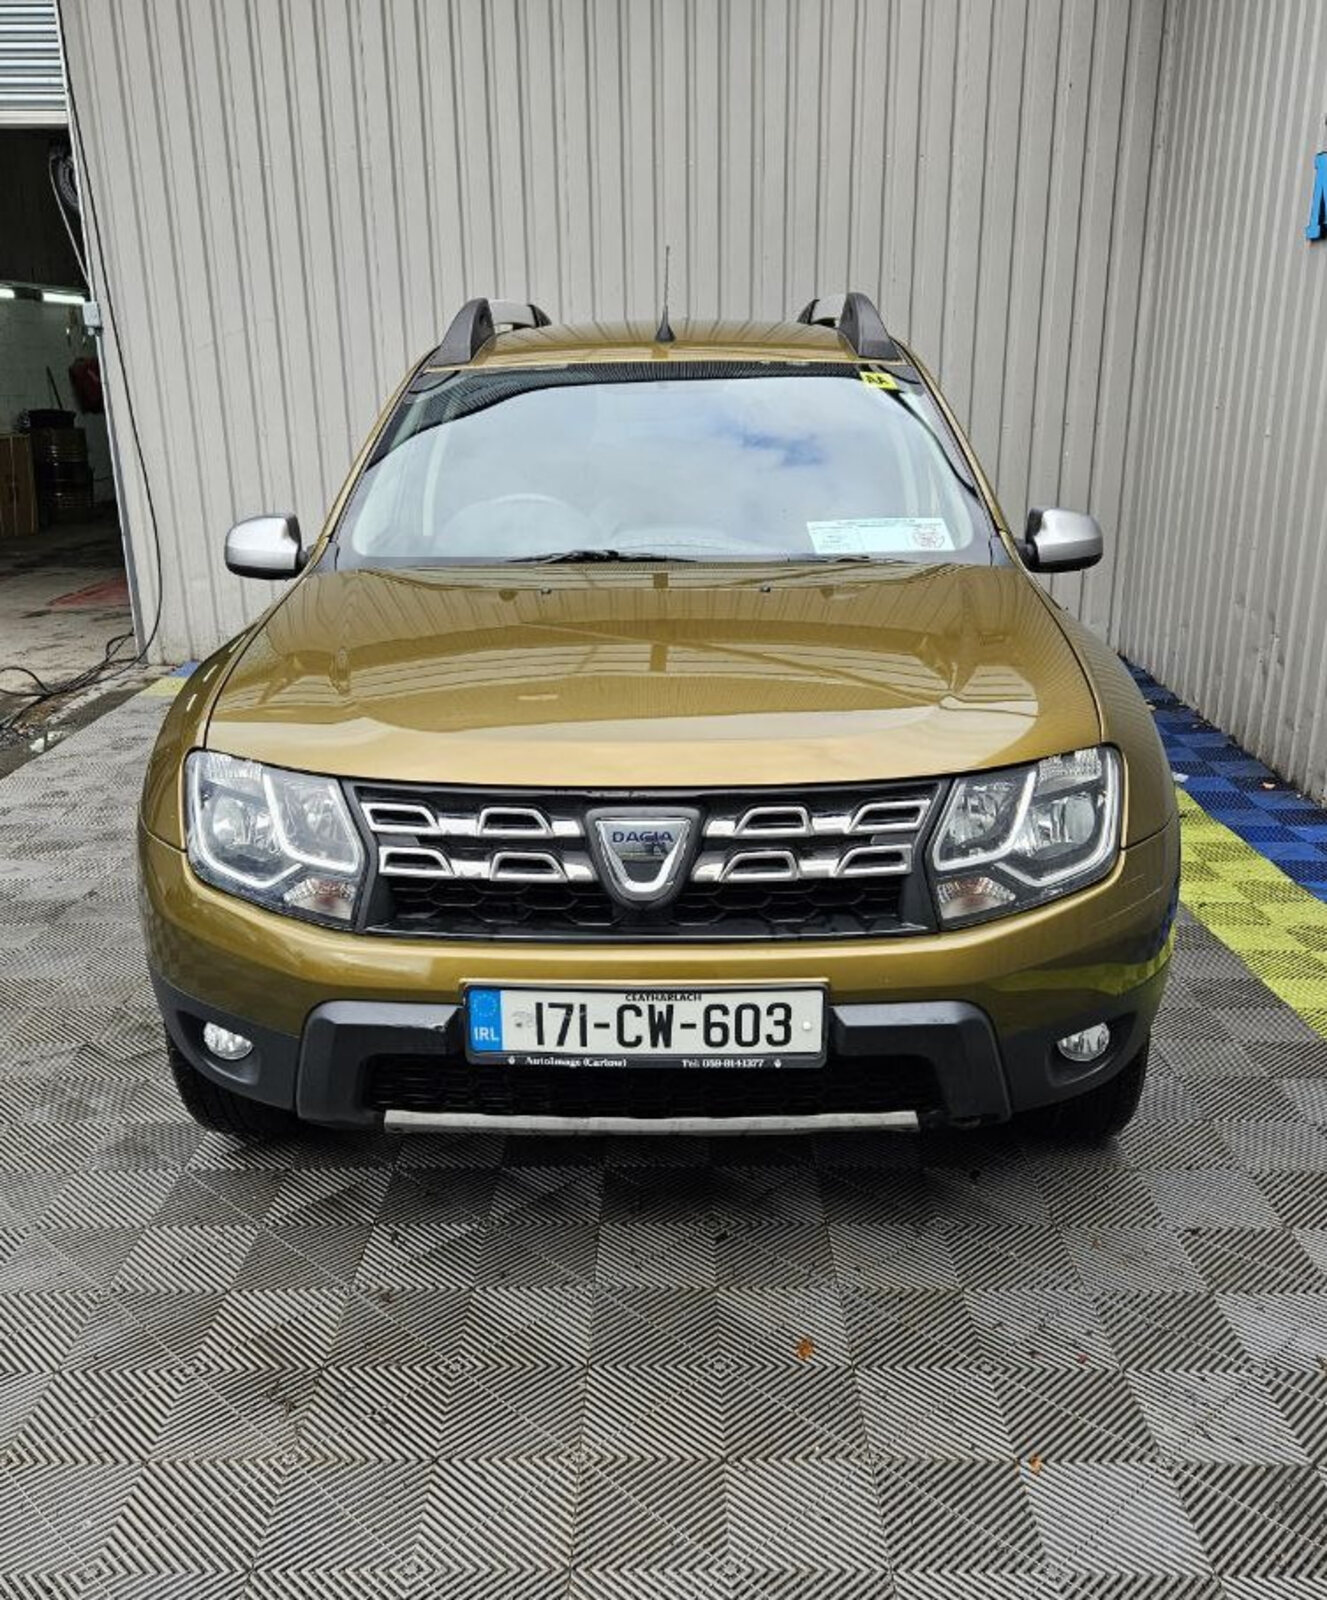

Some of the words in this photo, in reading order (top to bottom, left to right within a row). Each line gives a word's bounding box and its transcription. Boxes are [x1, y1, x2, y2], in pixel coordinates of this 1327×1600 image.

[613, 831, 673, 843] DACIA
[535, 1002, 792, 1048] 171-CW-603
[474, 1027, 499, 1041] IRL
